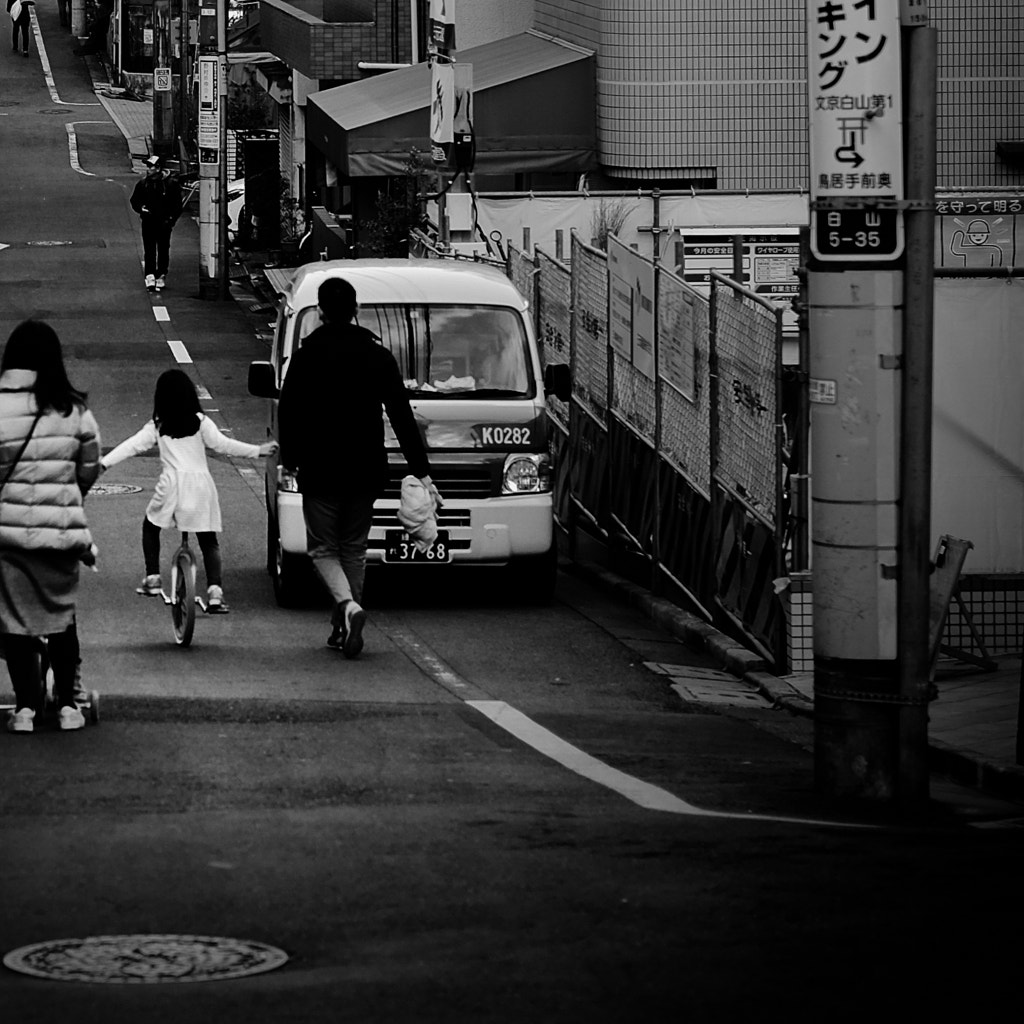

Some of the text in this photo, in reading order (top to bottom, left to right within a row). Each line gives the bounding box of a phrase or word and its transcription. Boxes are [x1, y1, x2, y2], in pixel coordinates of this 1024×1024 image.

[936, 200, 1022, 214] を守って明る
[829, 231, 881, 247] 5-35
[481, 427, 531, 445] K0282
